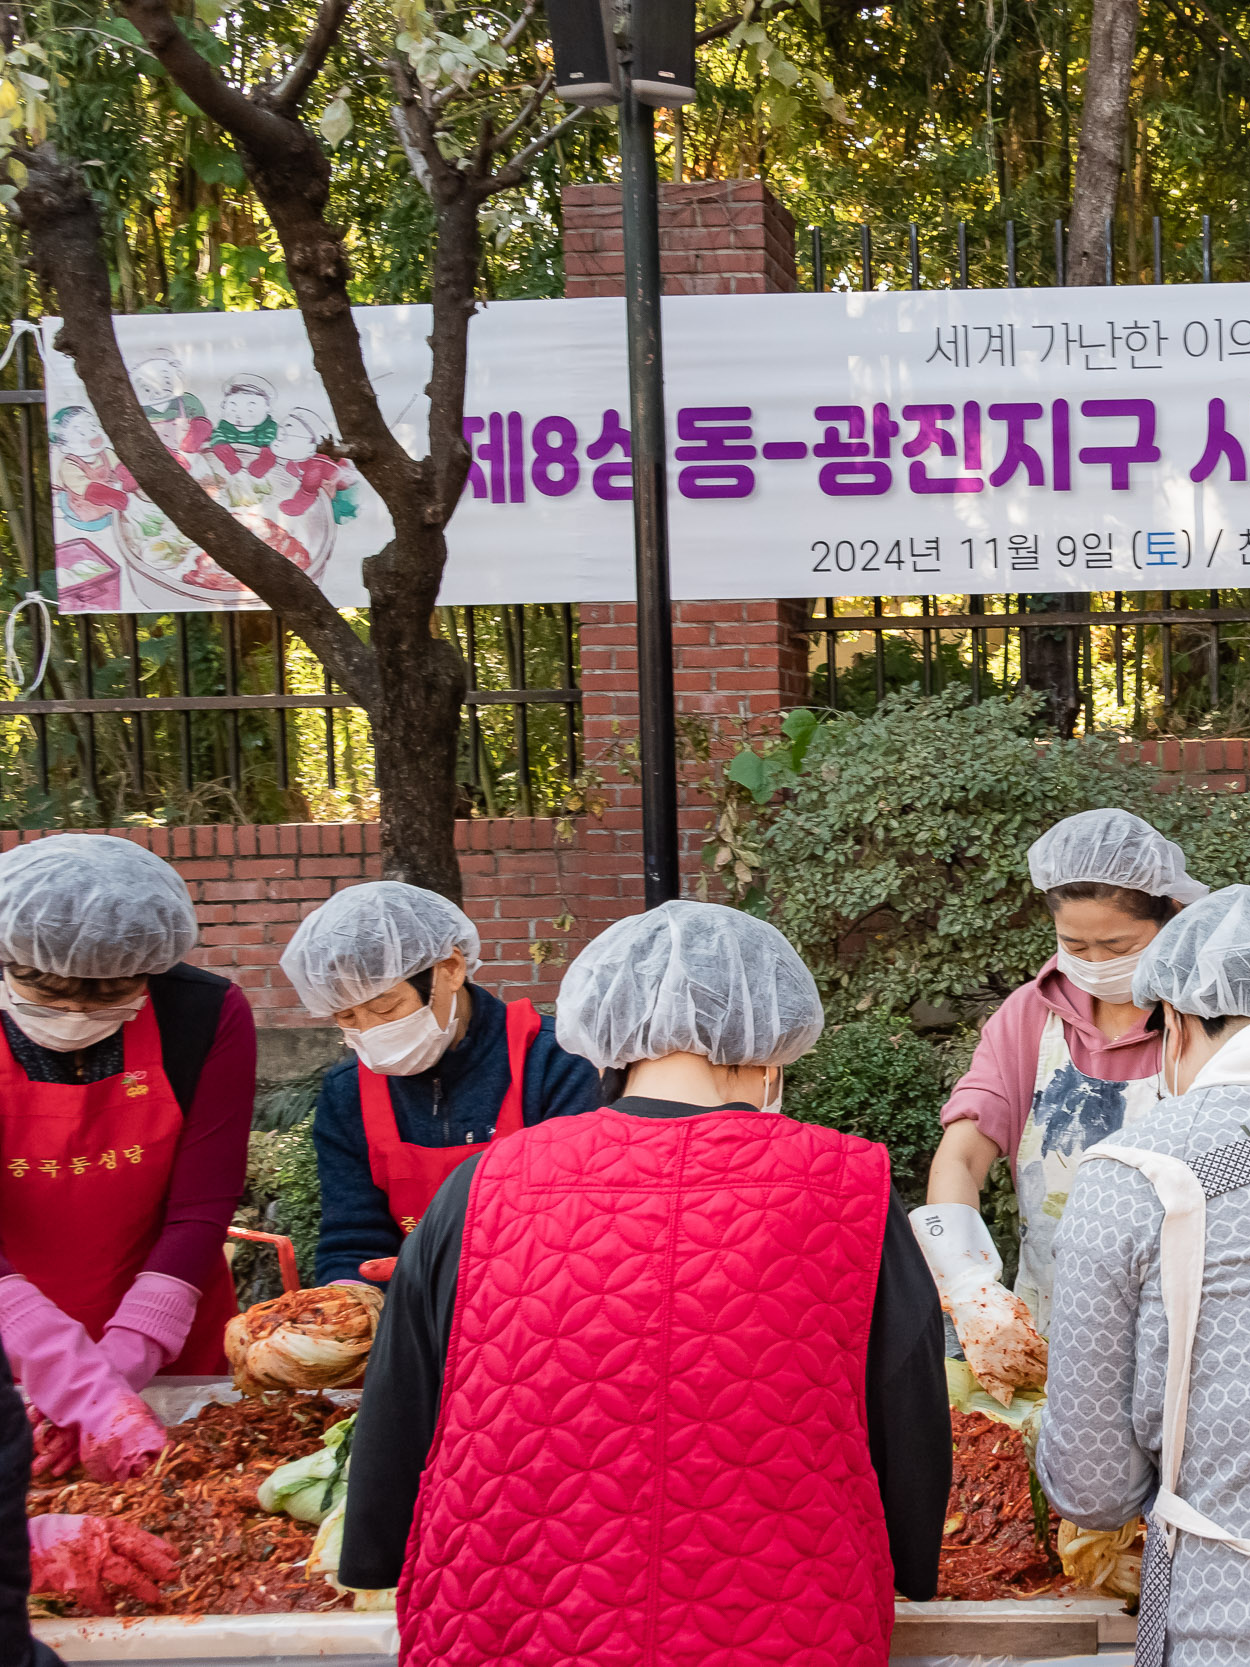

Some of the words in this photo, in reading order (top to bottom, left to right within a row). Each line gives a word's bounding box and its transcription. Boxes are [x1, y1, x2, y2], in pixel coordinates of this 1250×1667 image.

[926, 323, 1016, 368] 세계
[1032, 320, 1169, 371] 가난한
[811, 537, 942, 574] 2024년
[961, 534, 1040, 571] 11월
[1057, 533, 1114, 570] 9일
[1132, 530, 1193, 570] (토)
[7, 1144, 145, 1179] 중곡동성당
